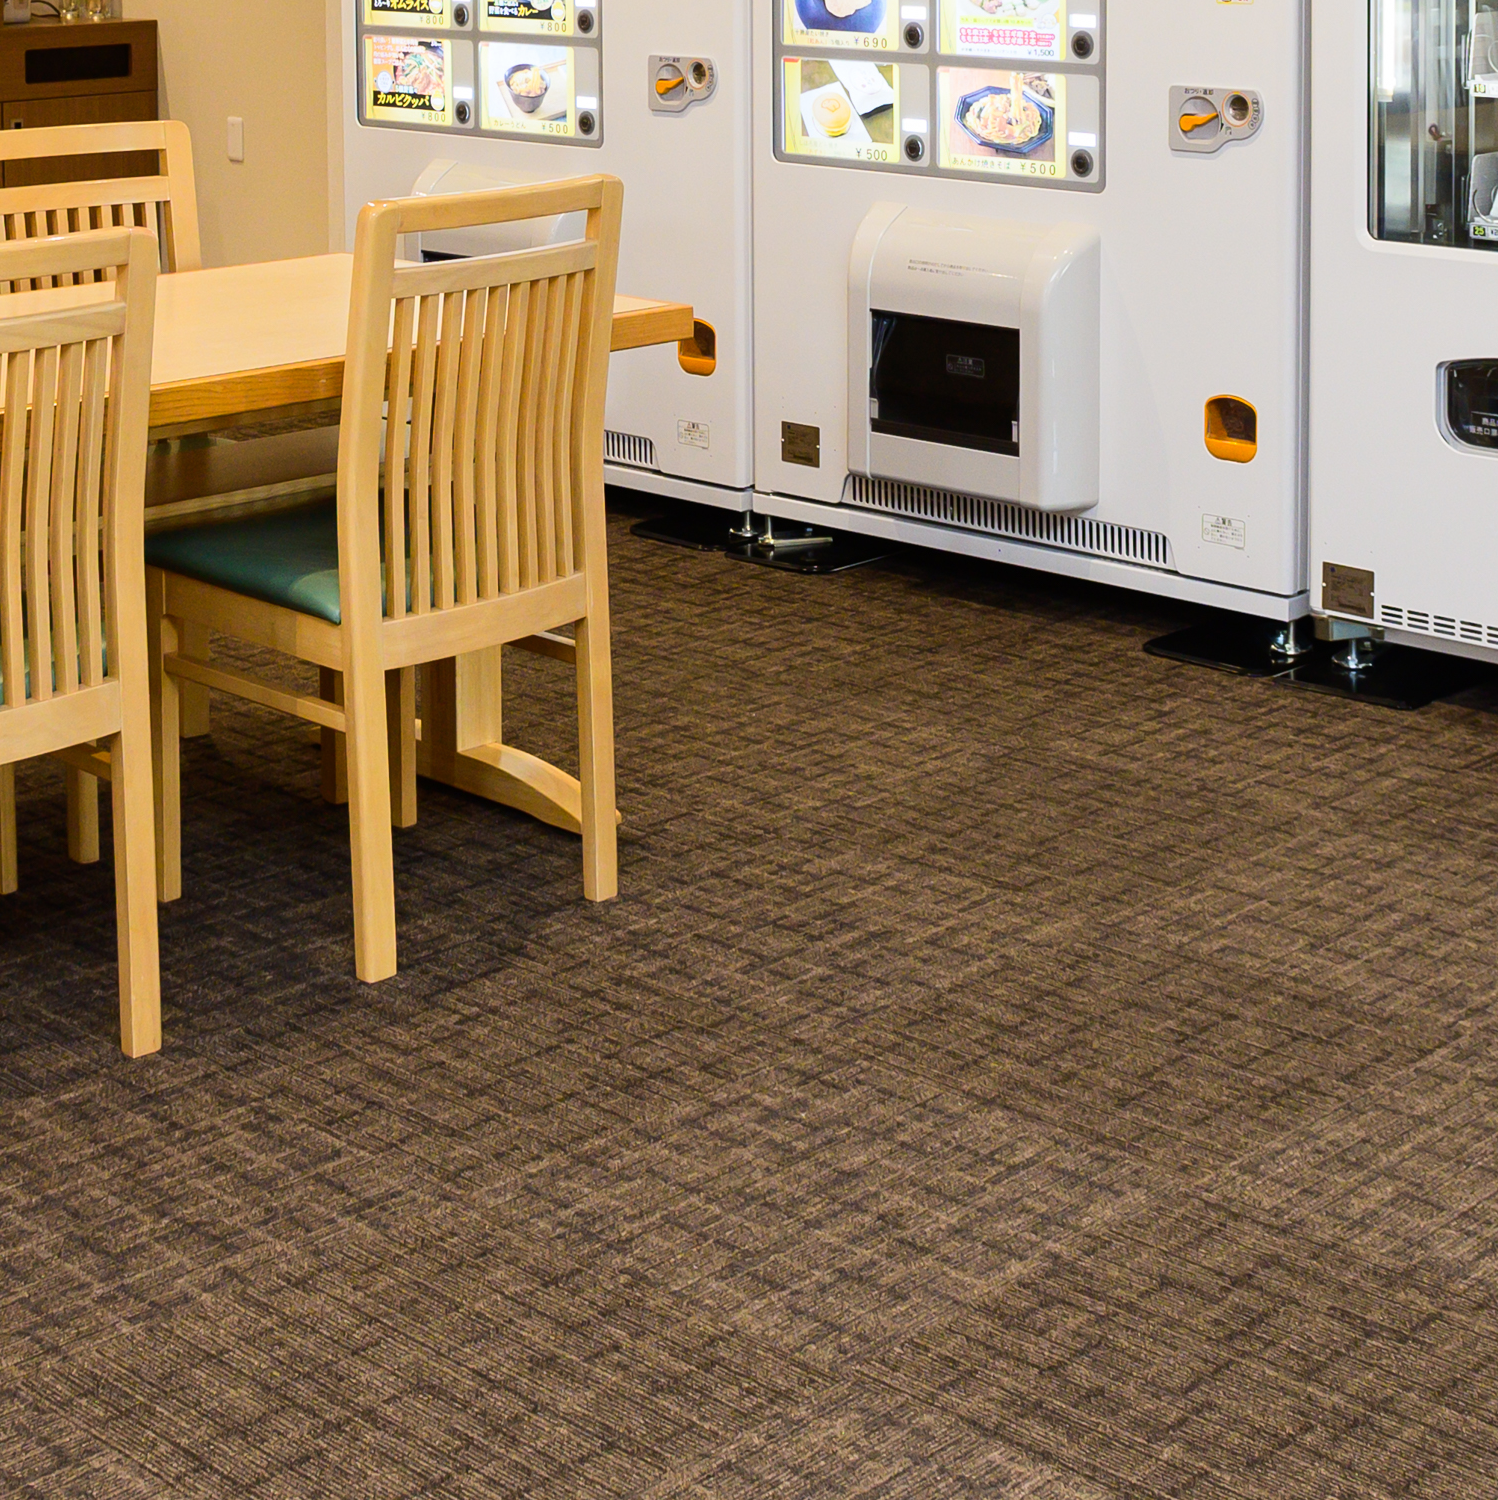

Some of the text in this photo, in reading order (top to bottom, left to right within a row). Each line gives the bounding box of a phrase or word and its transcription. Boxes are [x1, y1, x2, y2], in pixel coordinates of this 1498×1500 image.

[419, 15, 444, 25] ¥800
[540, 22, 567, 32] ¥800
[853, 36, 888, 49] ¥690
[1026, 47, 1054, 57] ¥1,500
[1474, 83, 1485, 93] 19
[377, 92, 430, 108] カルビクッパ
[422, 112, 446, 122] ¥800
[493, 120, 526, 129] カレーうどん
[541, 123, 568, 134] ¥500
[855, 146, 888, 161] ¥500
[952, 155, 1011, 170] あんかけ焼きそば
[1019, 161, 1056, 176] ¥500
[1473, 226, 1486, 235] 25
